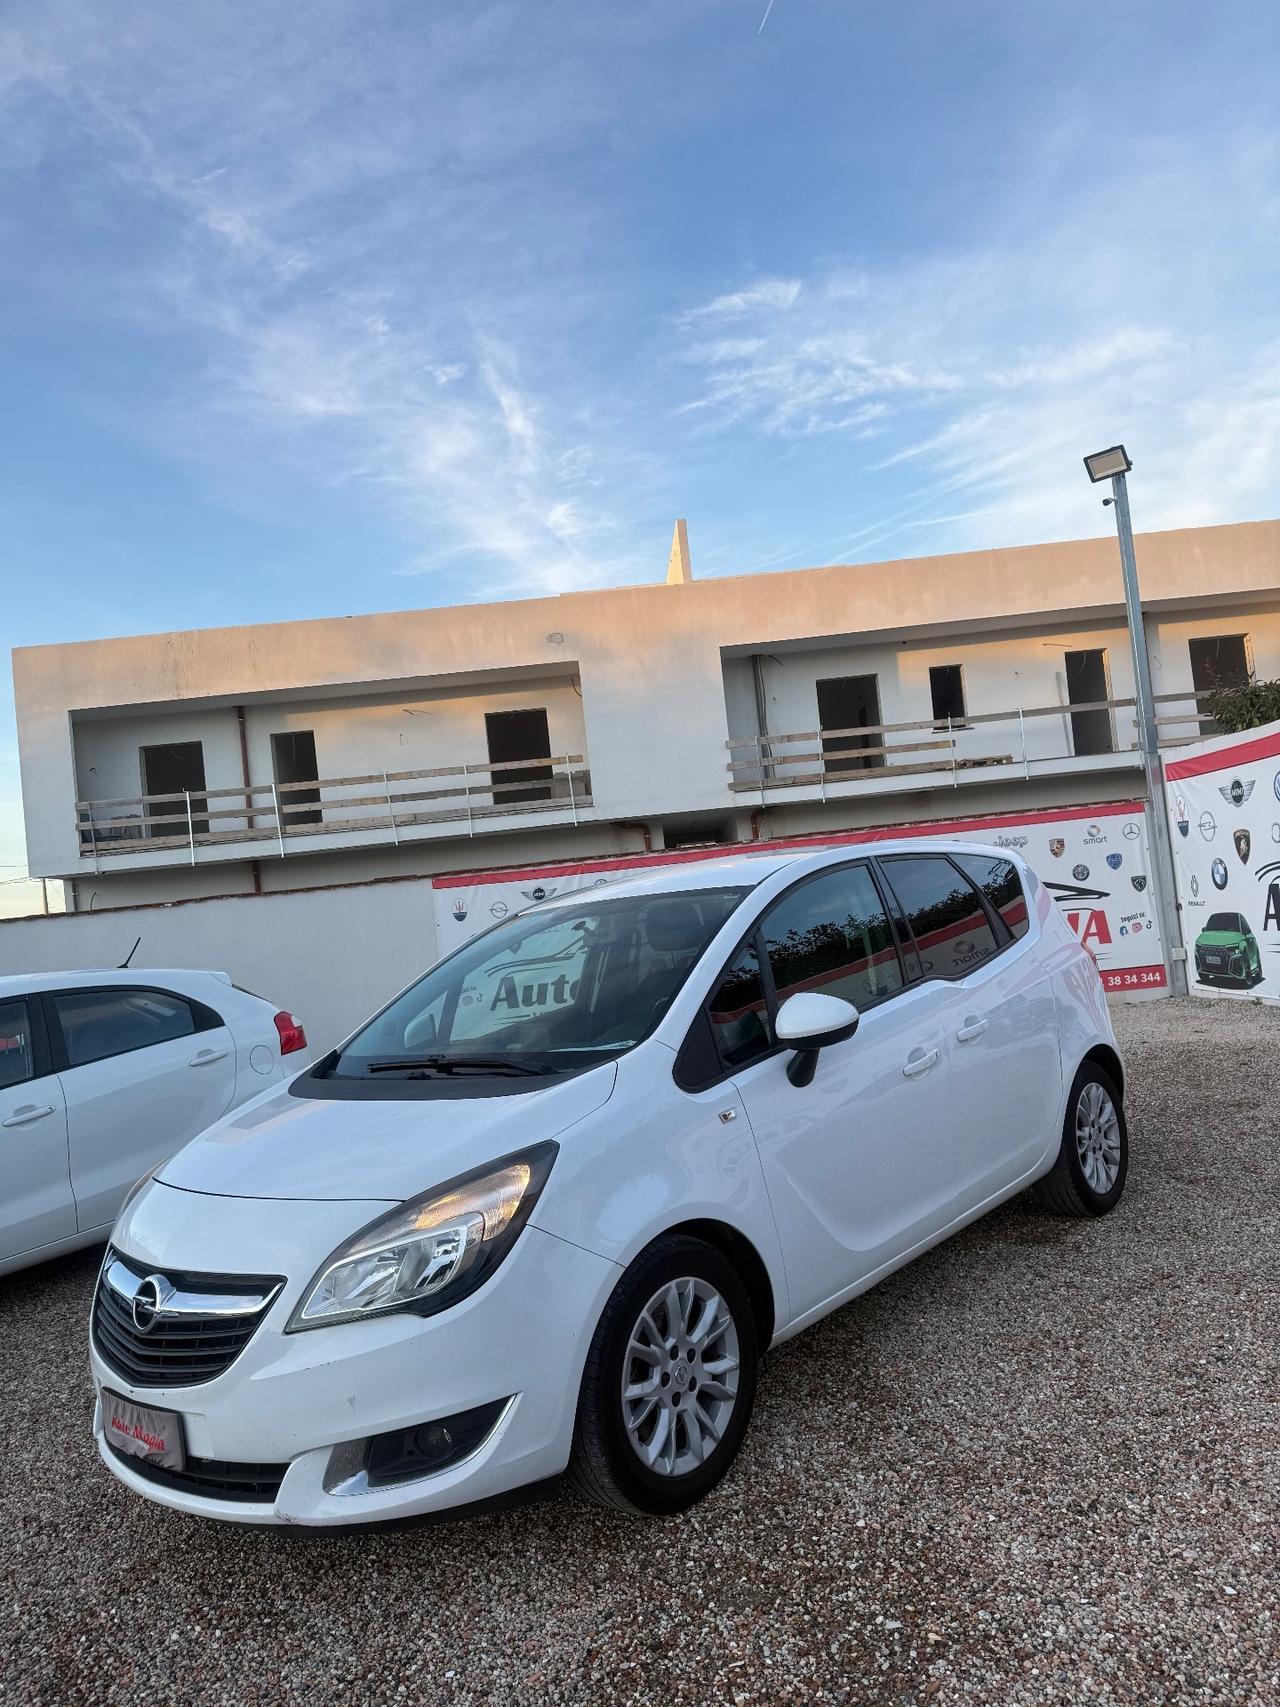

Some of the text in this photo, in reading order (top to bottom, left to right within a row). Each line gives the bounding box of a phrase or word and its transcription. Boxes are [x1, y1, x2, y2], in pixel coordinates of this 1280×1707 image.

[1083, 836, 1108, 845] smart
[1107, 976, 1121, 986] 38
[1124, 974, 1138, 984] 34
[1140, 972, 1161, 983] 344
[132, 1424, 165, 1452] Magia
